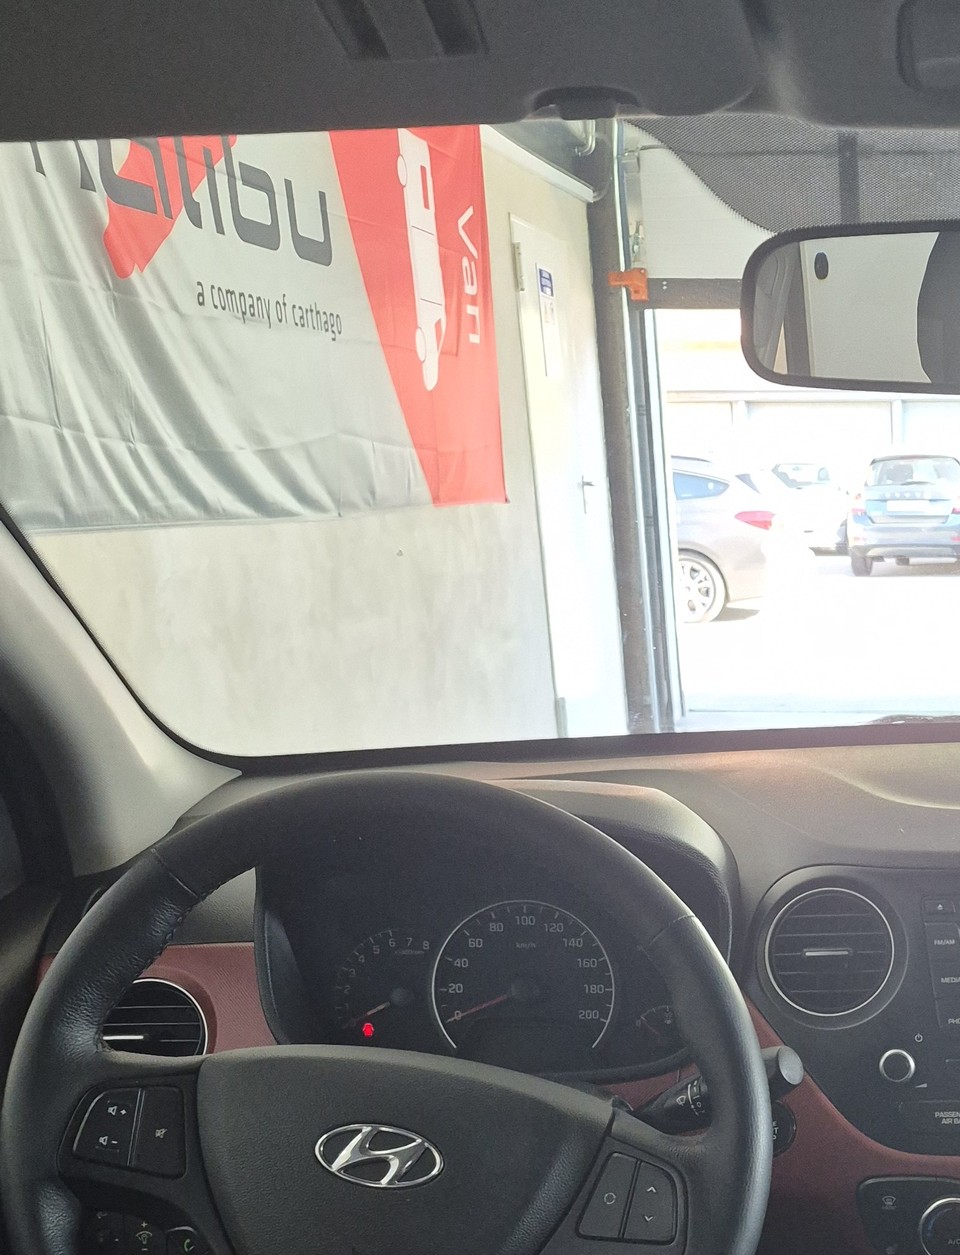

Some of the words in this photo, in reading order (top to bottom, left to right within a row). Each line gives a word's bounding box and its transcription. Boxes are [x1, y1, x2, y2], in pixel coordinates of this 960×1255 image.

[457, 205, 482, 344] Van
[196, 280, 206, 307] a
[210, 283, 272, 329] company
[275, 293, 288, 323] of
[292, 301, 343, 342] carthago
[515, 915, 536, 926] 100
[489, 922, 504, 932] 80
[543, 922, 564, 933] 120
[388, 938, 396, 948] 6
[406, 937, 413, 946] 7
[422, 940, 430, 950] 8
[468, 938, 483, 948] 60
[562, 938, 583, 948] 140
[373, 944, 380, 955] 5
[454, 958, 469, 968] 40
[577, 958, 598, 968] 160
[448, 983, 463, 993] 20
[583, 984, 604, 994] 180
[578, 1009, 599, 1019] 200
